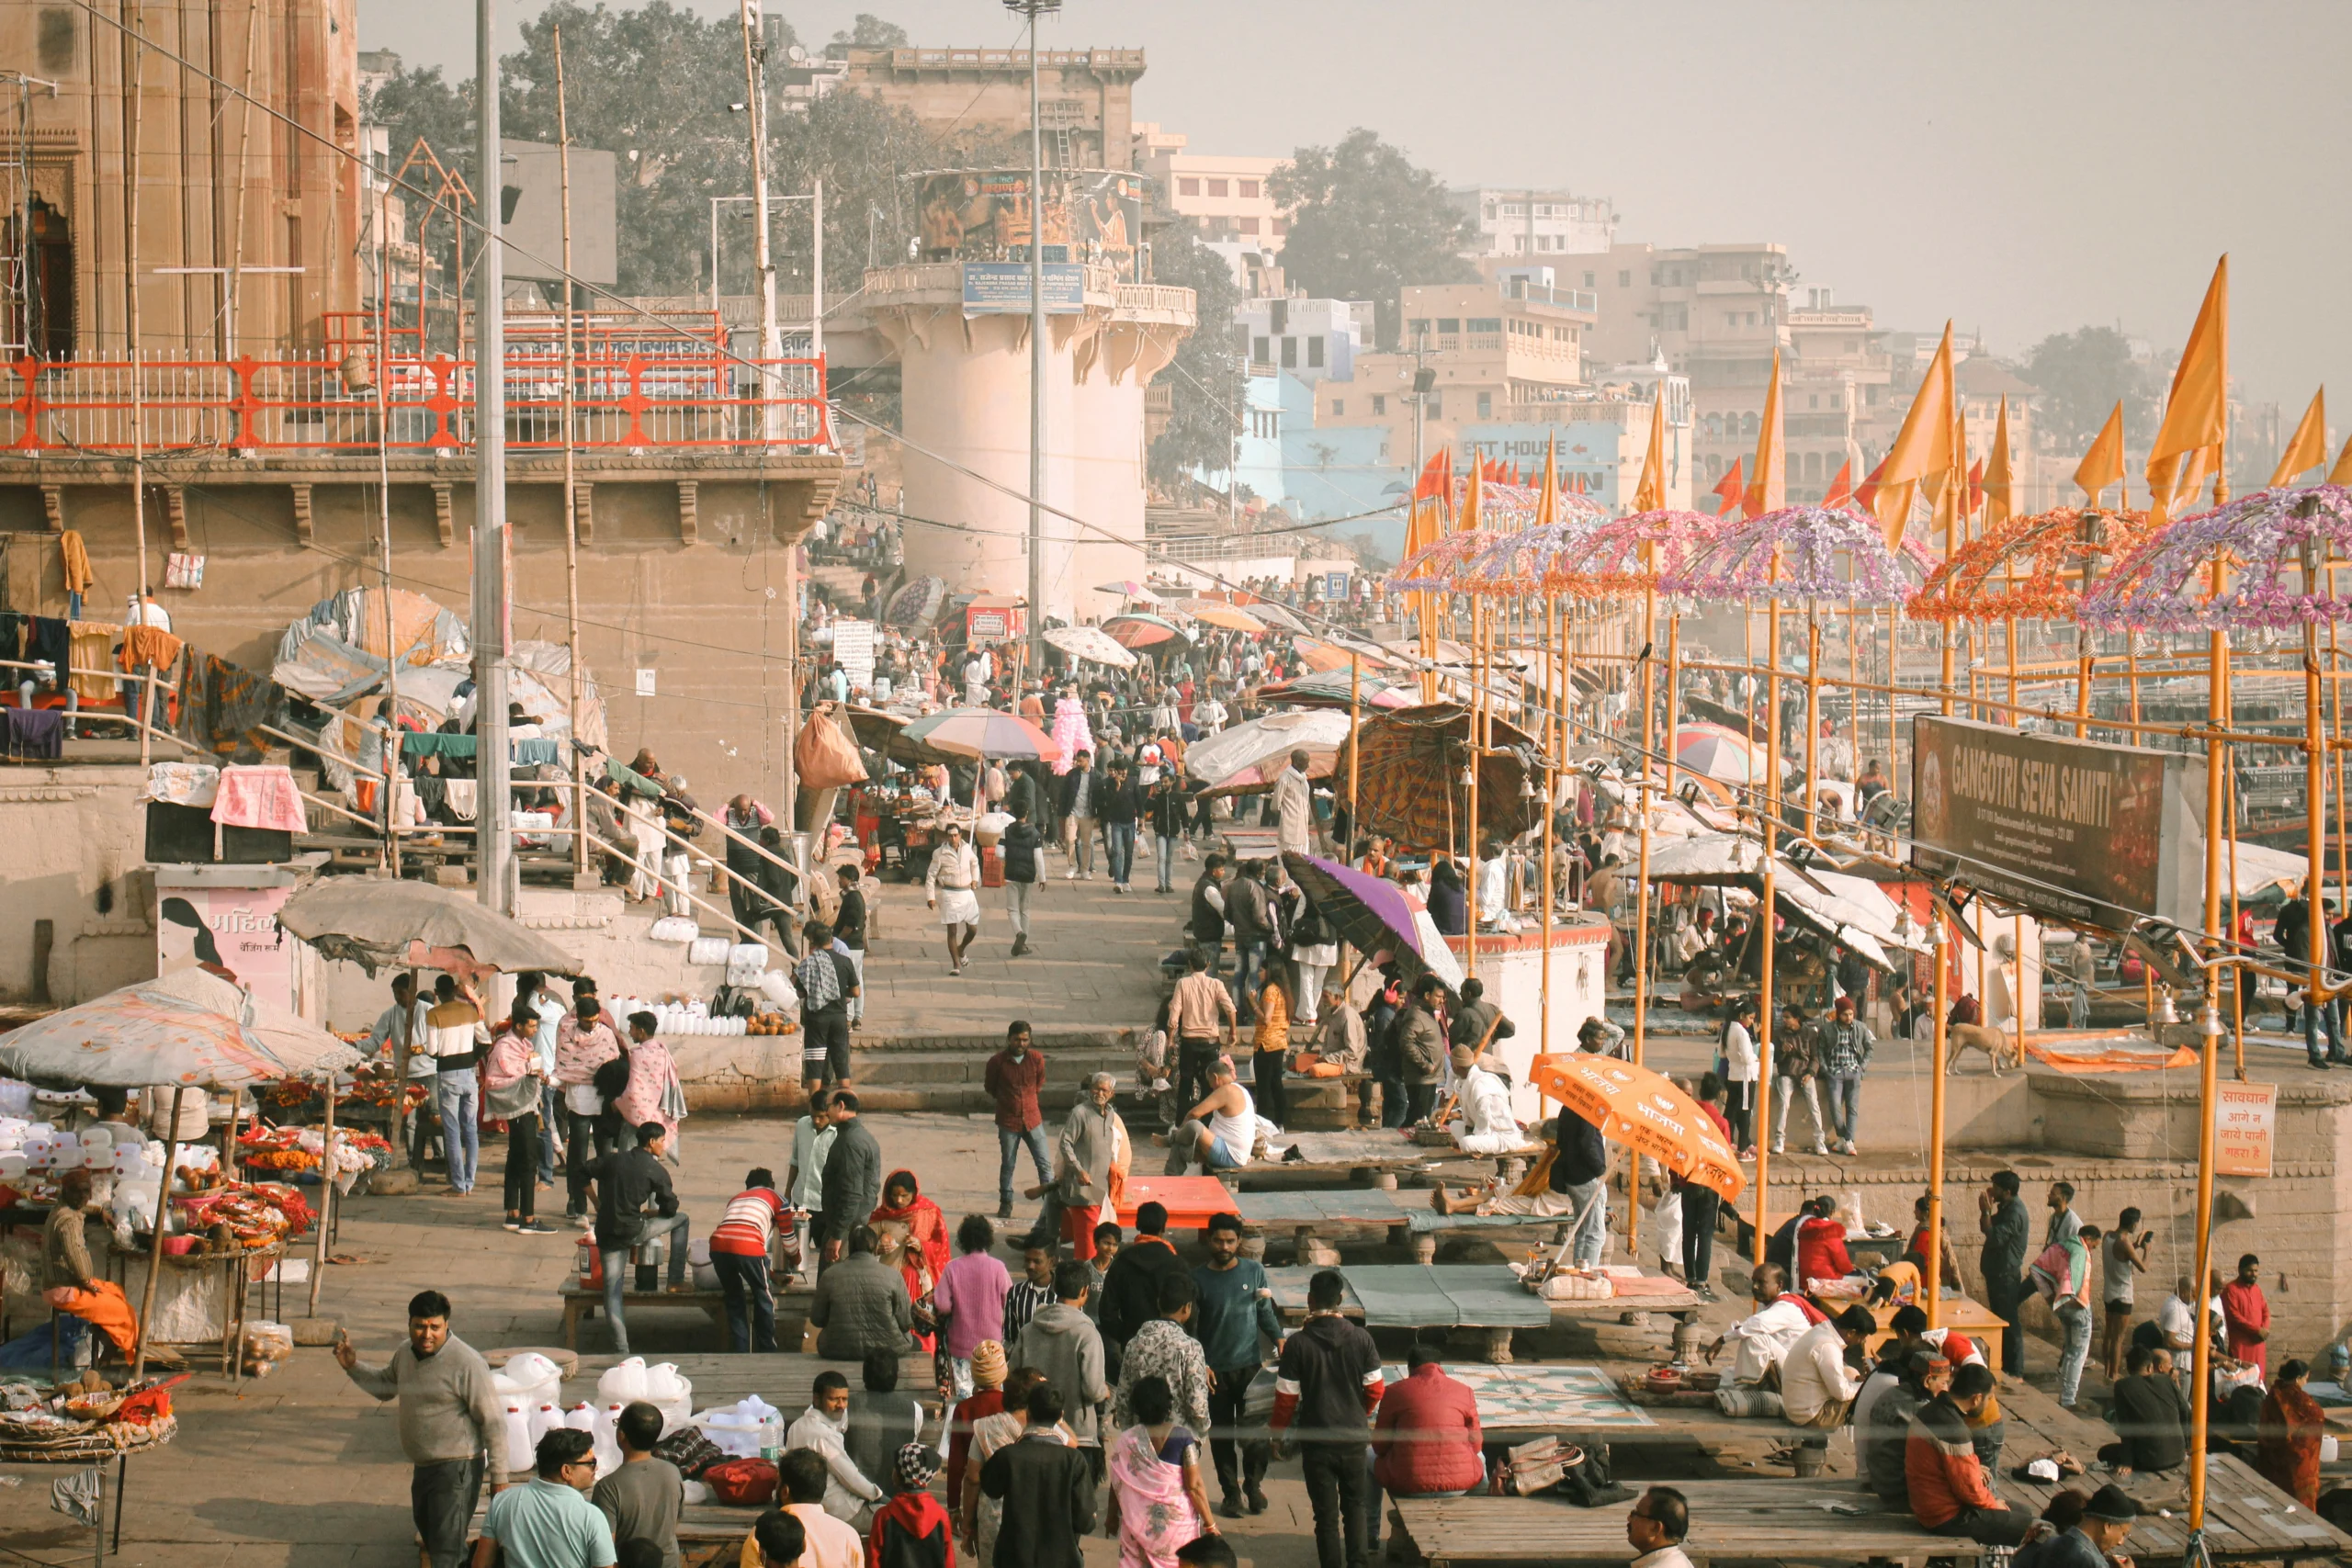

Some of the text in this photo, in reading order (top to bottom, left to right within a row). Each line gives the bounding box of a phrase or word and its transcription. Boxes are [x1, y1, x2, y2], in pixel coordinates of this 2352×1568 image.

[1504, 441, 1566, 456] HOUSE
[1951, 744, 2112, 829] GANGOTRI SEVA SAMITI
[239, 941, 279, 953] चेंजिंग रूम
[1580, 1066, 1621, 1095] भाजपा
[2222, 1090, 2269, 1105] सावधान
[1637, 1101, 1687, 1137] भाजपा
[2228, 1109, 2262, 1124] आगे न
[1639, 1124, 1673, 1146] एक भारत
[2220, 1127, 2267, 1142] जाये पानी
[2225, 1145, 2261, 1159] गहरा है
